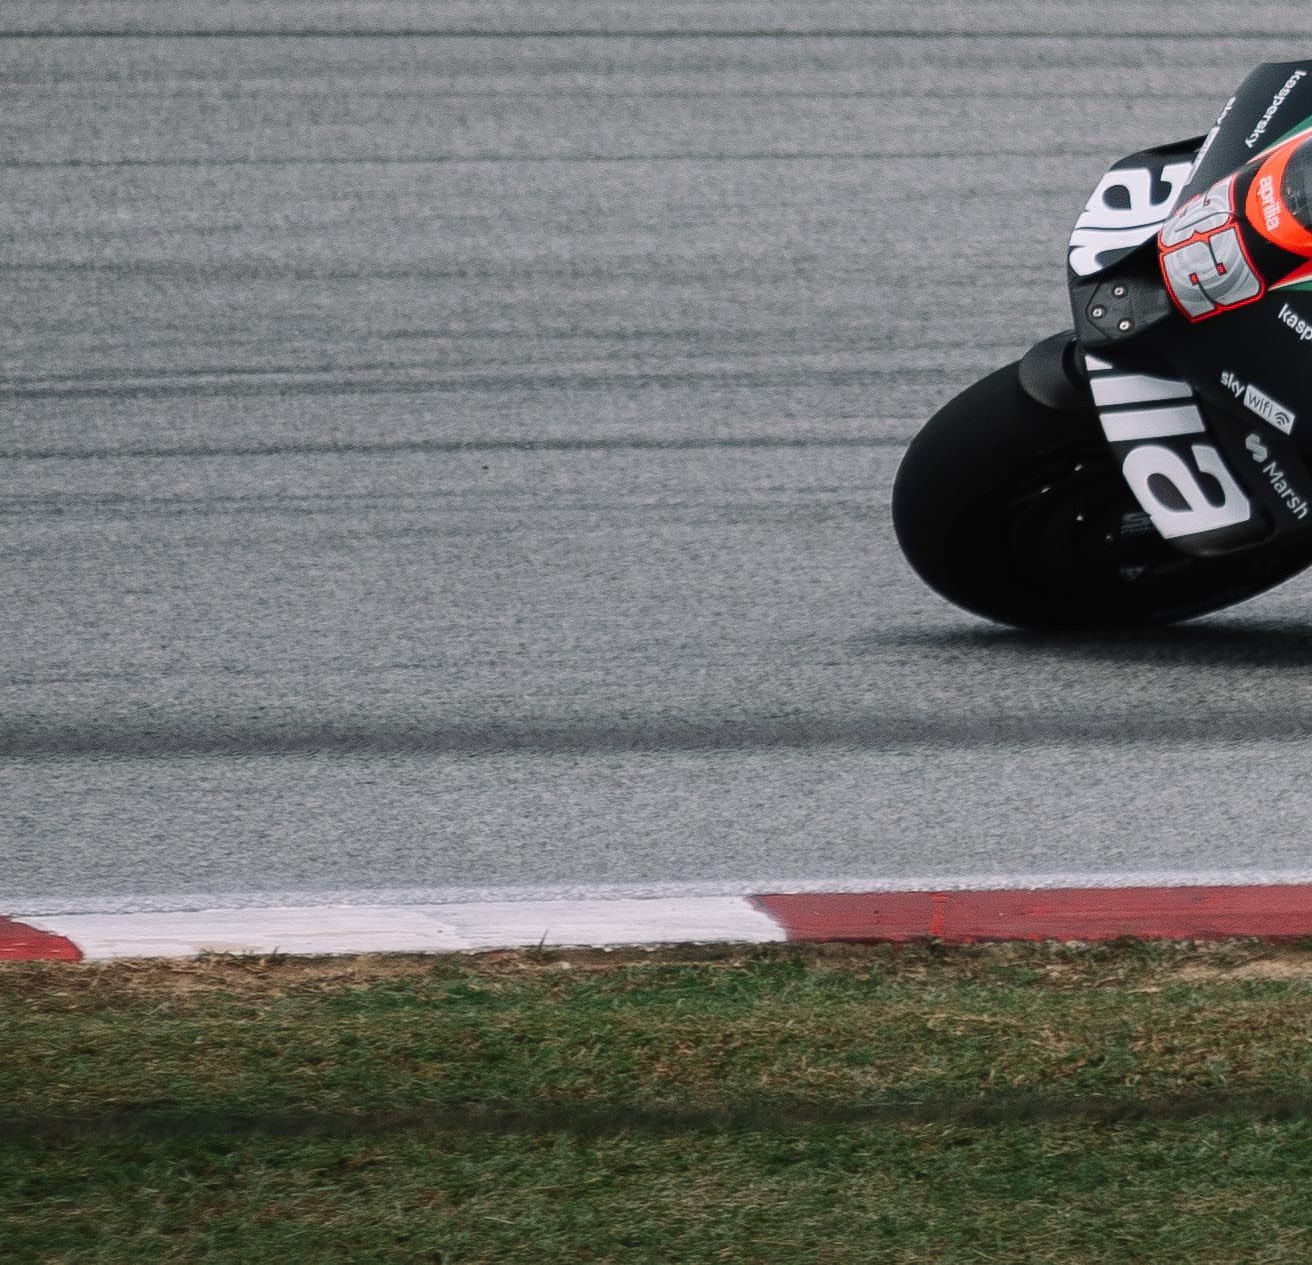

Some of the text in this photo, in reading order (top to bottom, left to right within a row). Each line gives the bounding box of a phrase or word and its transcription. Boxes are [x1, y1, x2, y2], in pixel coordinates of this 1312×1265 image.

[1244, 69, 1307, 149] kaspersky
[1219, 369, 1246, 400] sky
[1262, 460, 1310, 521] Marsh
